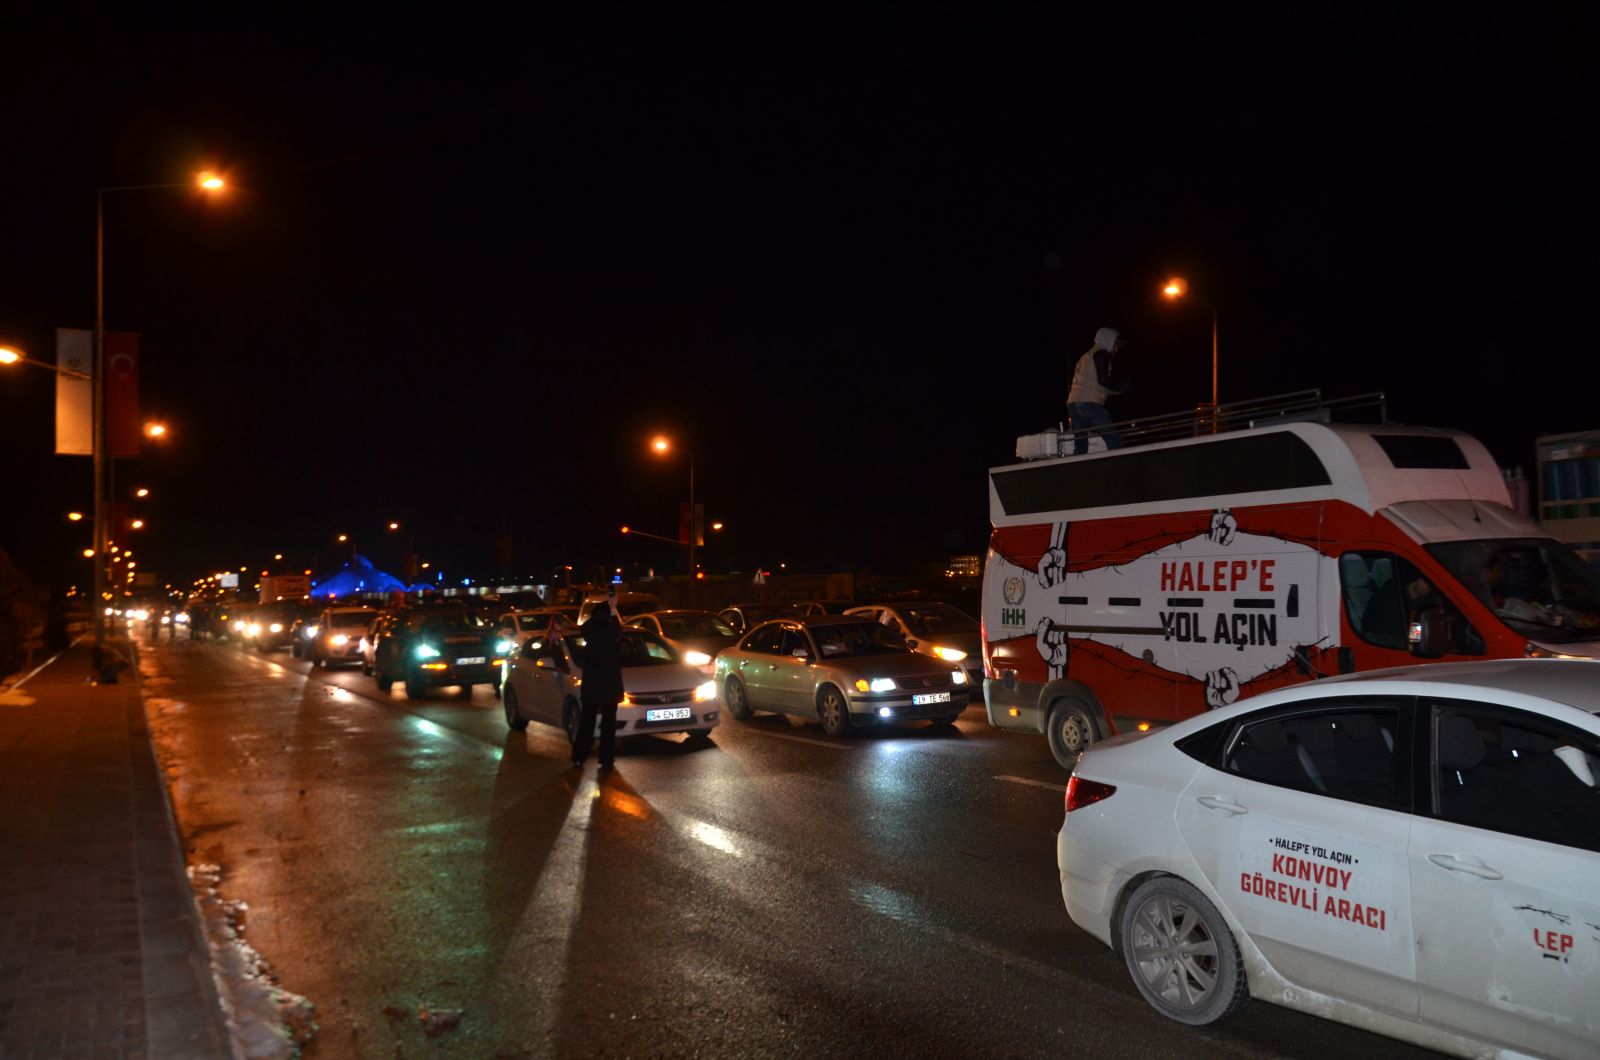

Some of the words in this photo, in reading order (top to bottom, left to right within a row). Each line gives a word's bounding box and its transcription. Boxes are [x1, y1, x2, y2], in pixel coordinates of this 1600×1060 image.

[1161, 560, 1275, 592] HALEP'E
[1159, 612, 1207, 643] YOL
[1213, 613, 1277, 651] AÇIN
[651, 711, 661, 719] 54
[1275, 838, 1310, 854] HALEP'E
[1312, 846, 1328, 859] YOL
[1330, 851, 1352, 864] AÇIN
[1272, 853, 1352, 891] KONVOY
[1241, 872, 1318, 912] GÖREVLİ
[1324, 896, 1386, 931] ARACI
